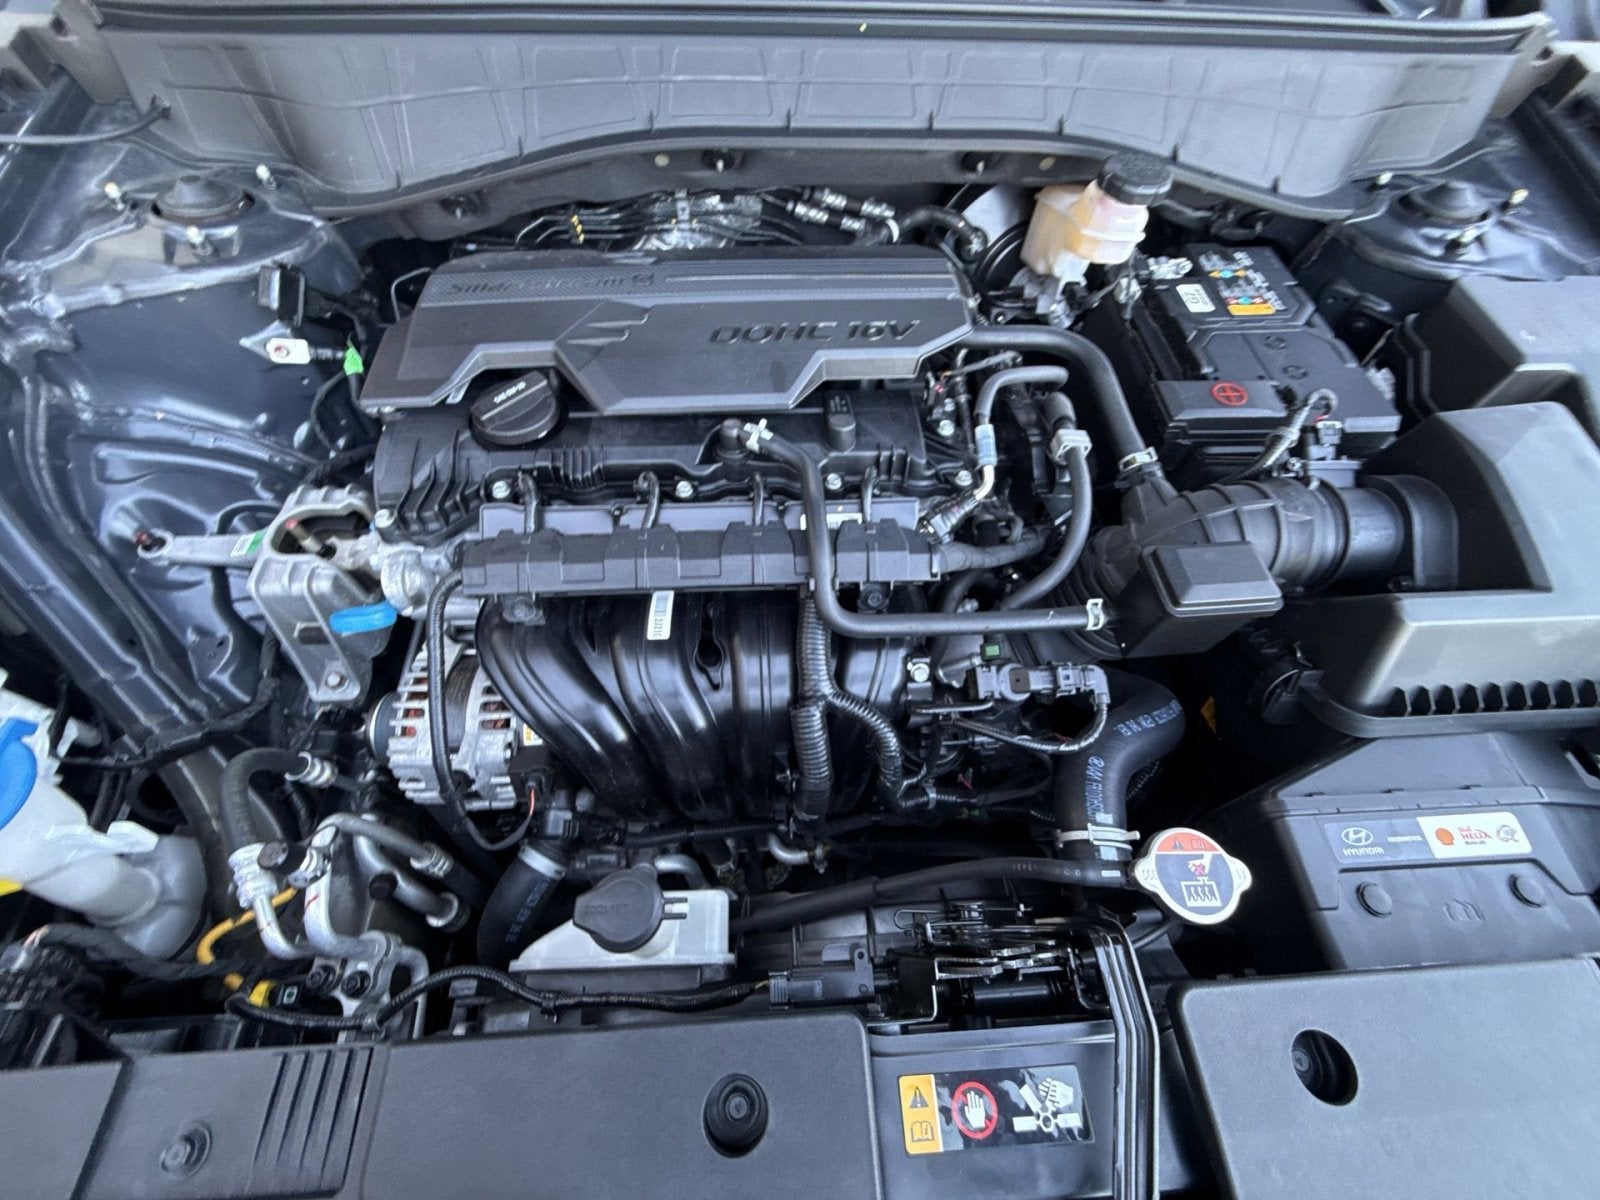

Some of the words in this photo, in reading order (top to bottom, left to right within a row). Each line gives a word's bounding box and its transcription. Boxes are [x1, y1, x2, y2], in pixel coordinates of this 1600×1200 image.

[709, 320, 838, 345] DOHC
[848, 318, 922, 342] 16V
[1461, 831, 1492, 841] HELIX
[1343, 847, 1384, 856] HYUNDAI
